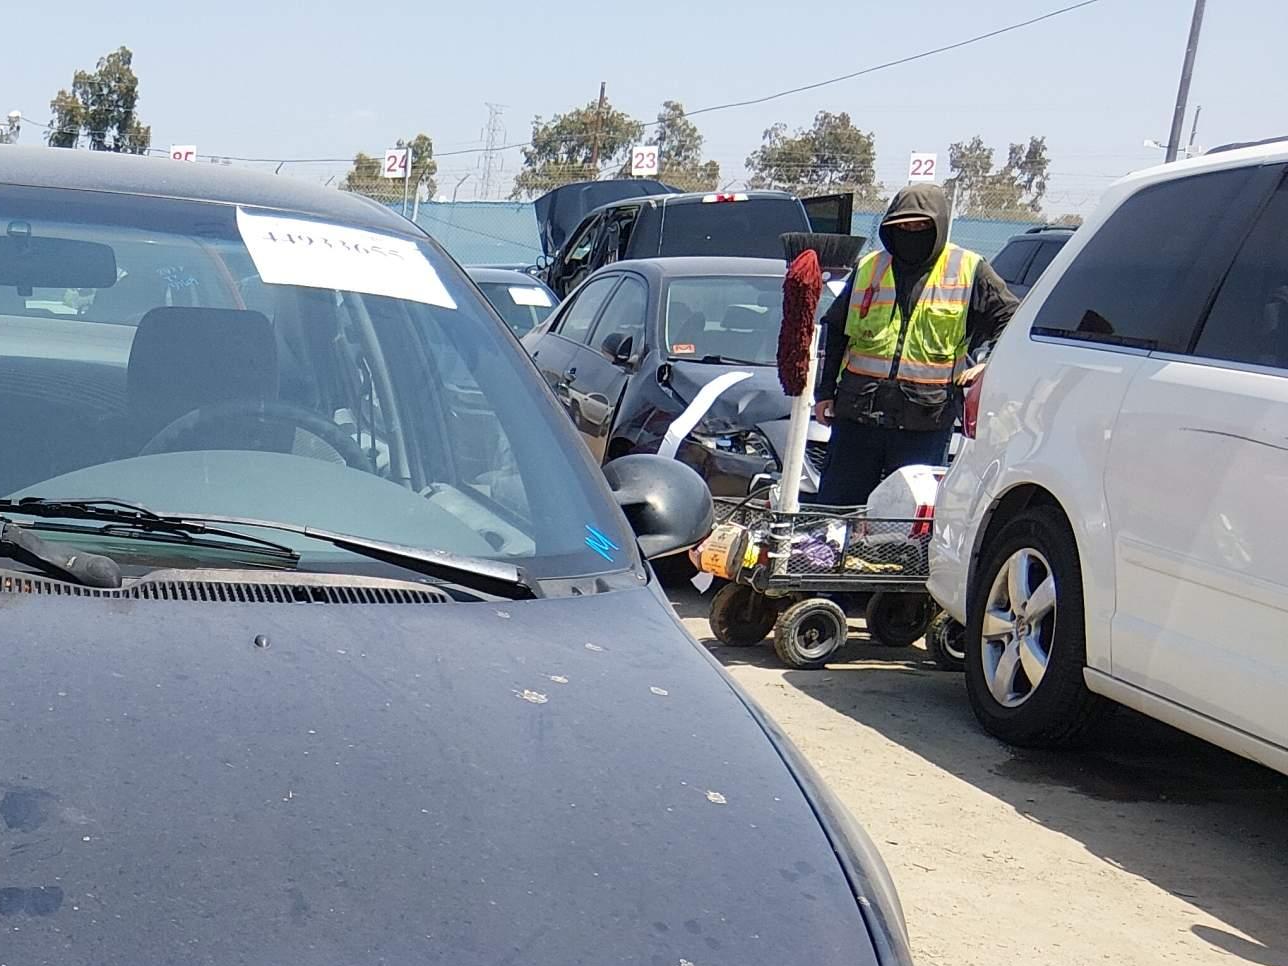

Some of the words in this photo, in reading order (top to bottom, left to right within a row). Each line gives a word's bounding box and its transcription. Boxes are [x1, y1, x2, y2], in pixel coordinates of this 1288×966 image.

[386, 154, 408, 173] 24
[634, 152, 656, 169] 23
[910, 159, 935, 176] 22
